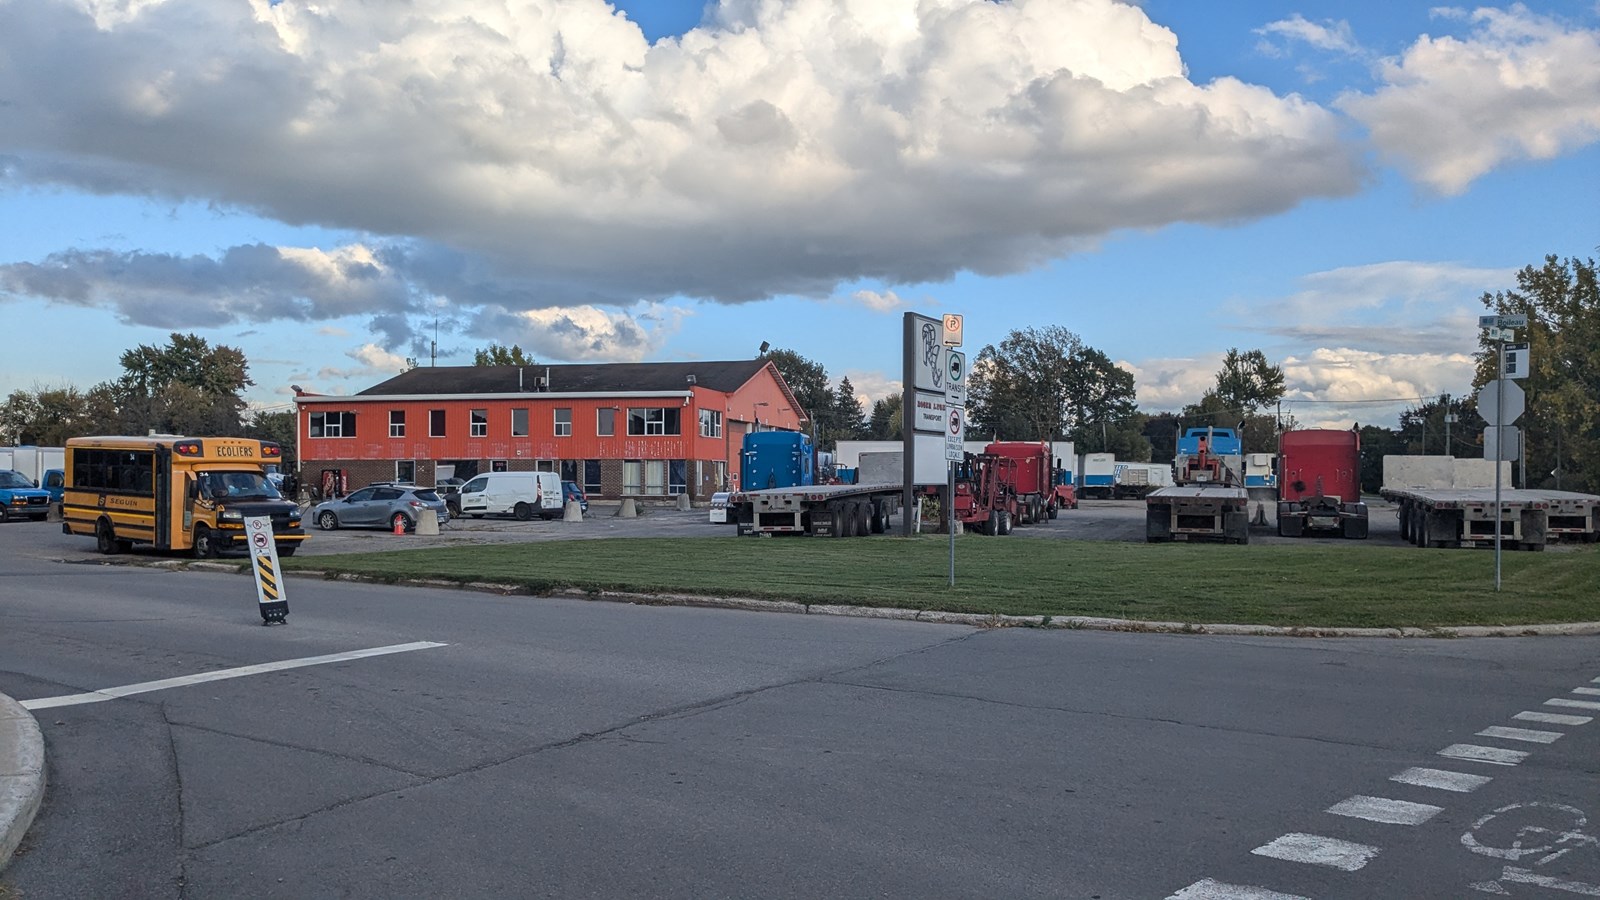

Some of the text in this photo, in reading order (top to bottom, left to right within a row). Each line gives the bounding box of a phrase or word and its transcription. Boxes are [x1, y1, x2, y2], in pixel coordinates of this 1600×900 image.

[1497, 318, 1524, 326] Boileau
[946, 382, 964, 393] TRANSIT
[923, 412, 942, 421] TRANSPORT
[216, 446, 253, 457] ECOLIERS
[948, 450, 961, 459] LOCALE
[110, 497, 138, 506] SEGUIN
